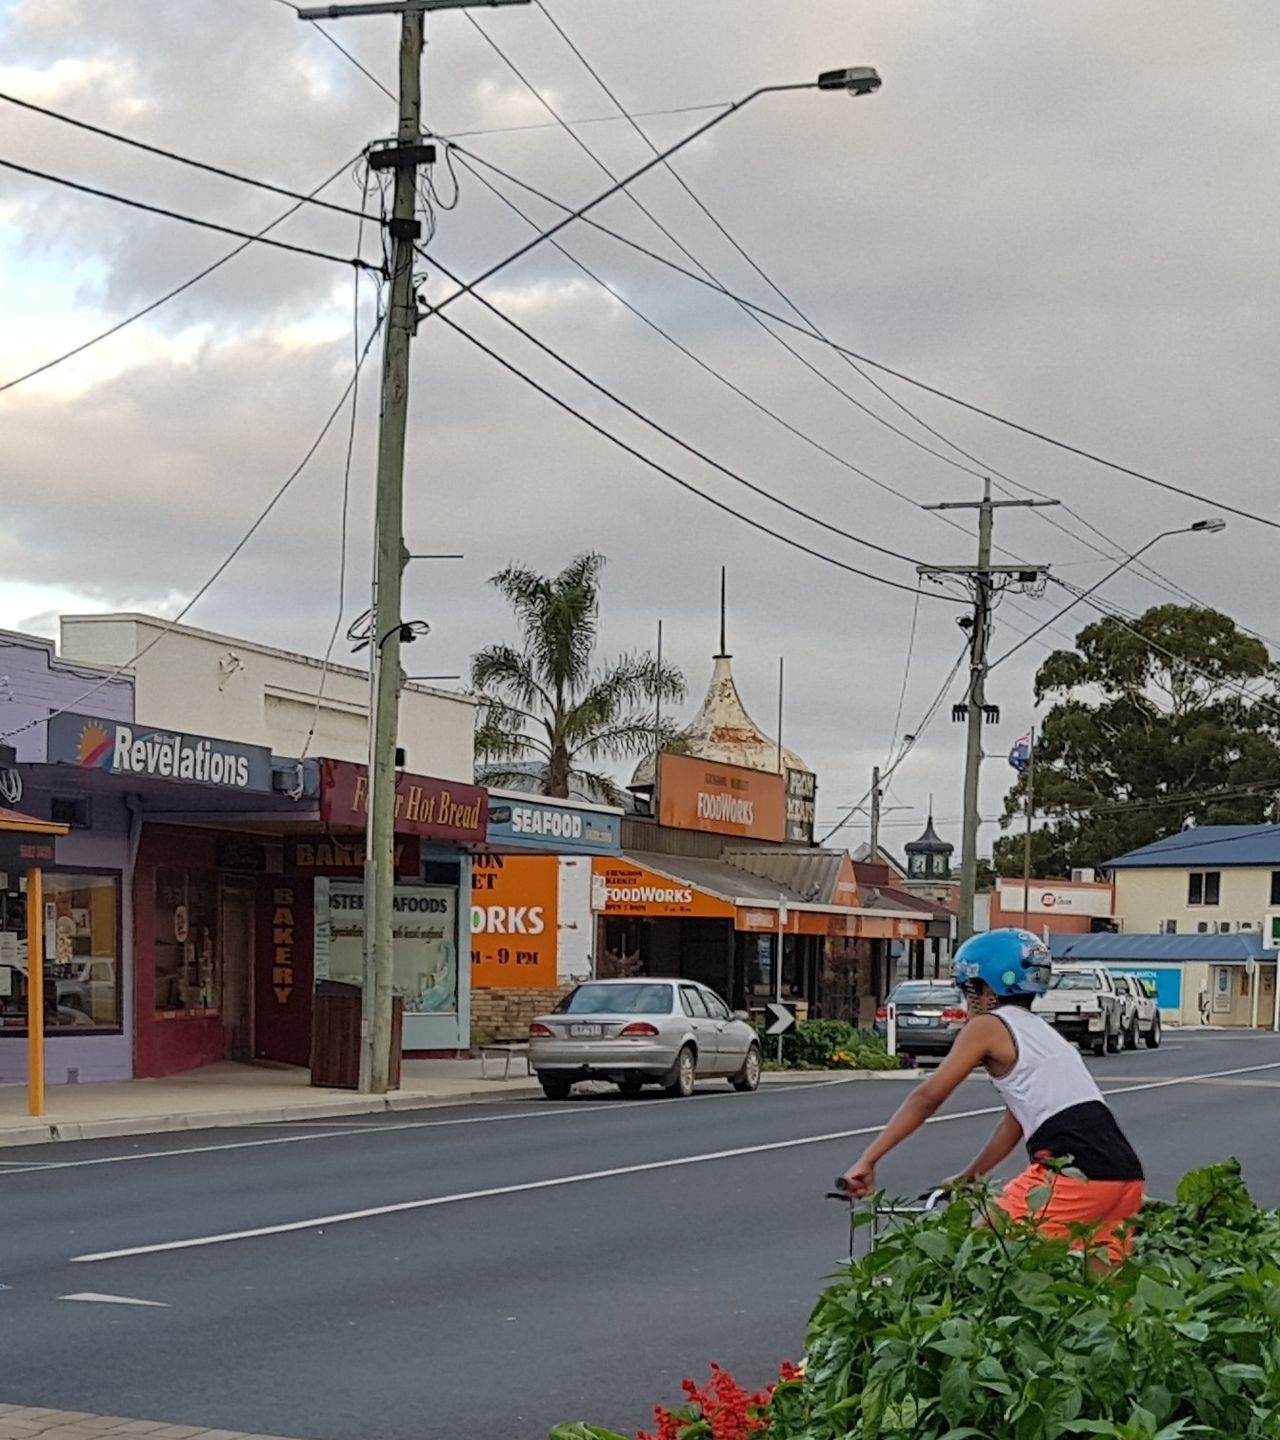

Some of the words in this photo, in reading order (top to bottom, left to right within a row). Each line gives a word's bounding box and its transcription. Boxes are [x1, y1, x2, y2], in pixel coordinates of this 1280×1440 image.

[112, 725, 249, 787] Revelations
[406, 786, 435, 824] Hot
[437, 791, 481, 829] Bread
[512, 807, 582, 838] SEAFOOD
[296, 844, 405, 866] BAKEY
[393, 897, 448, 914] AFOODS
[273, 888, 294, 1004] BAKERY
[497, 948, 509, 964] 9
[516, 951, 538, 964] PM
